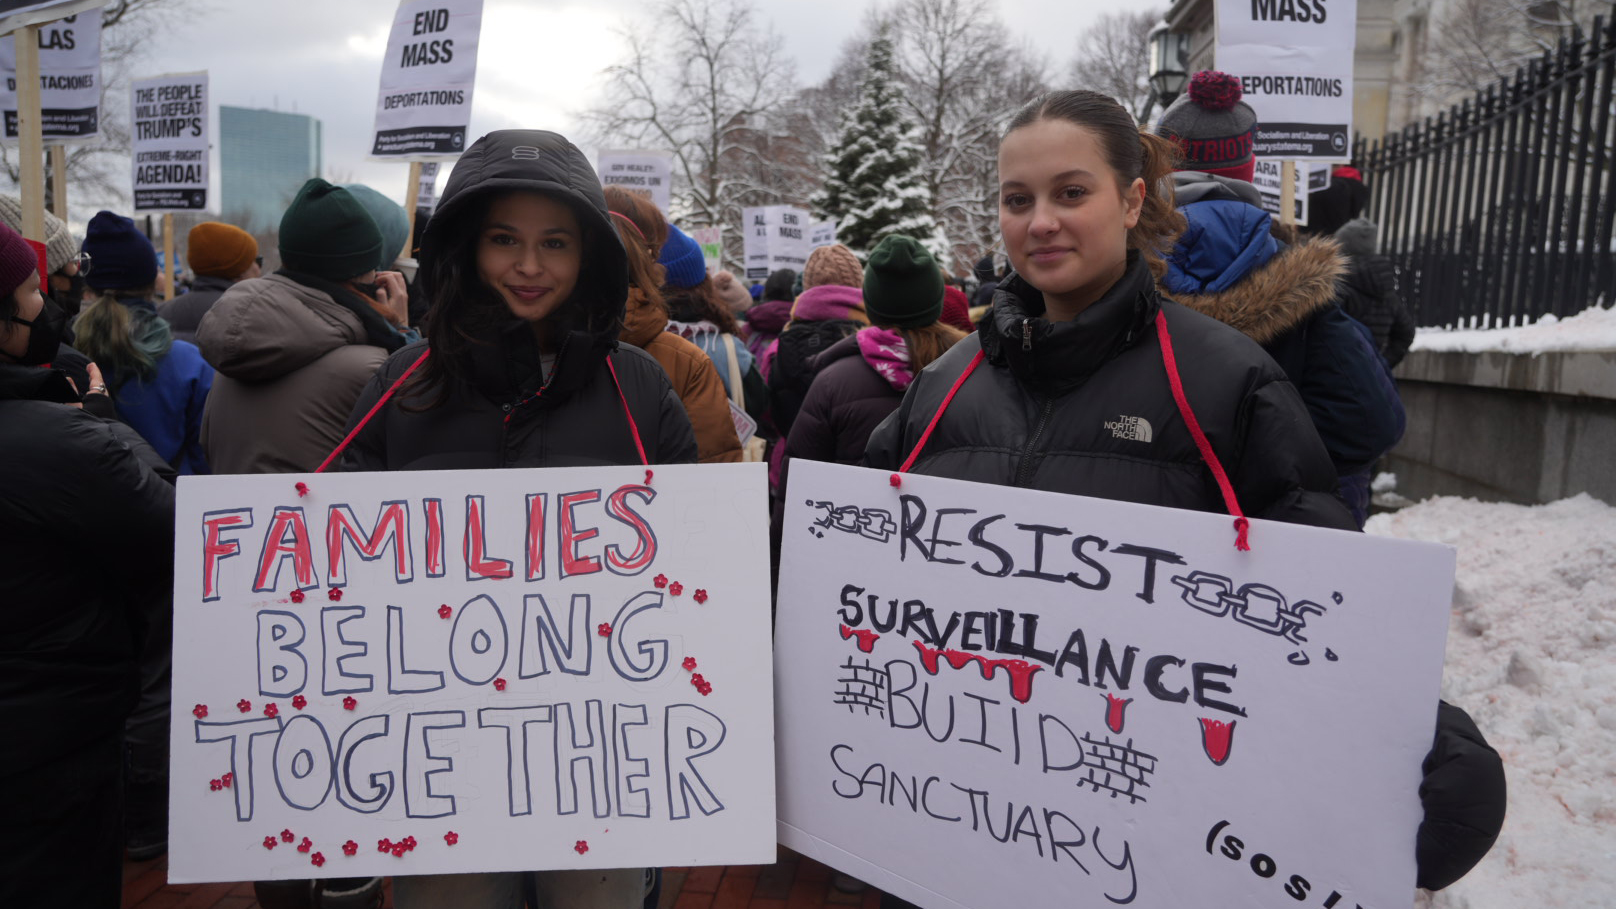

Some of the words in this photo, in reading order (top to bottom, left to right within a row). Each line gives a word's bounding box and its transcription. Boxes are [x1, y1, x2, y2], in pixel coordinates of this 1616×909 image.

[413, 8, 449, 36] END
[1251, 0, 1327, 24] MASS
[37, 29, 75, 50] LAS
[400, 39, 454, 68] MASS
[7, 74, 93, 91] DTACIONES
[1241, 75, 1342, 97] EPORTATIONS
[136, 88, 154, 104] THE
[158, 84, 203, 101] PEOPLE
[384, 90, 464, 110] DEPORTATIONS
[136, 104, 159, 119] WILL
[161, 101, 202, 118] DEFEAT
[136, 117, 202, 140] TRUMP'S
[1257, 131, 1290, 140] Socialism
[137, 150, 203, 163] EXTREME-RIGHT
[137, 164, 202, 184] AGENDA!
[1256, 161, 1278, 177] ARA
[783, 213, 799, 225] END
[779, 227, 803, 240] MASS
[1104, 421, 1136, 432] NORTH
[1120, 415, 1138, 424] THE
[1112, 430, 1135, 441] FACE
[201, 483, 657, 603] FAMILIES
[899, 494, 1187, 604] RESIST
[256, 591, 669, 698] BELONG
[836, 584, 1247, 717] SURVEILLANCE
[194, 699, 727, 821] TOGETHER
